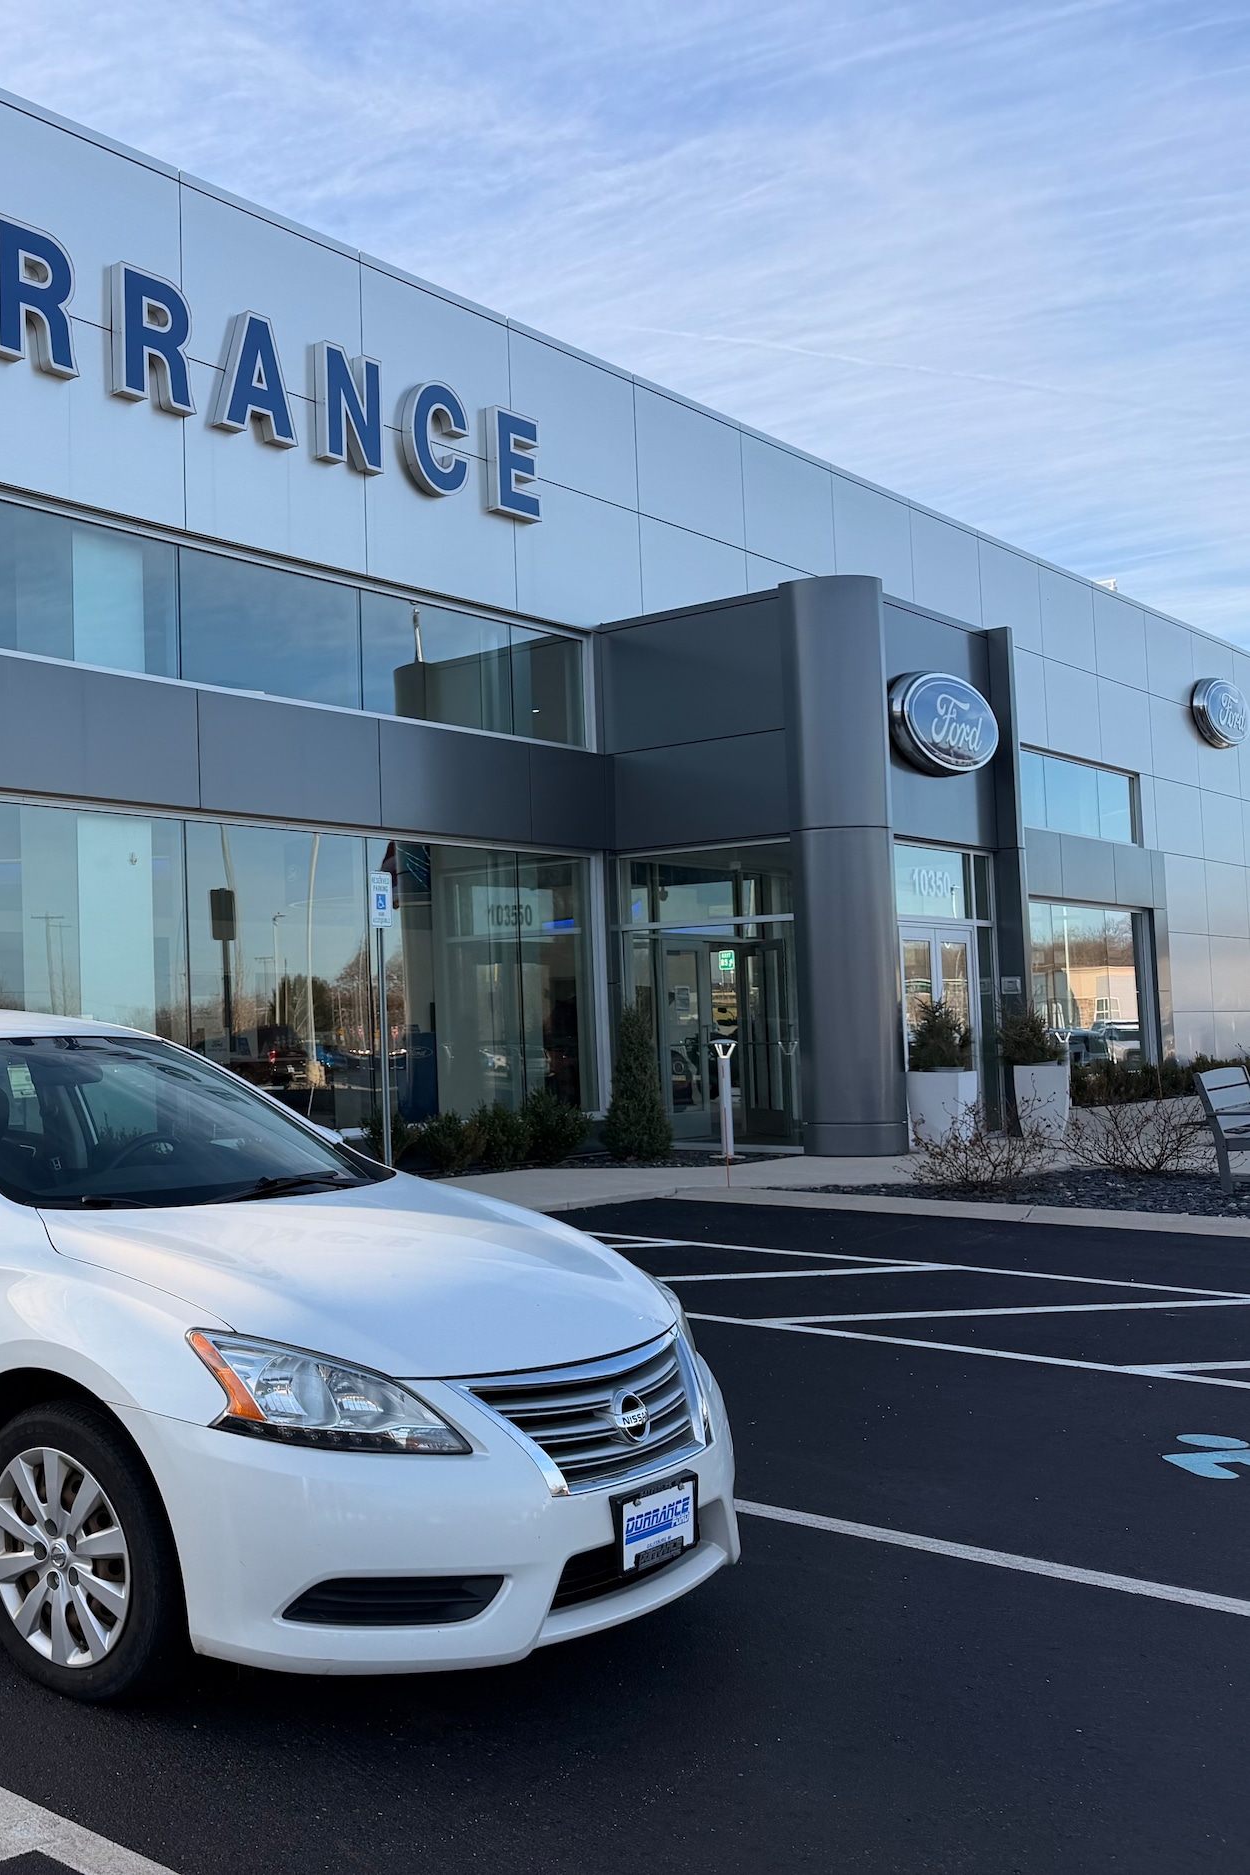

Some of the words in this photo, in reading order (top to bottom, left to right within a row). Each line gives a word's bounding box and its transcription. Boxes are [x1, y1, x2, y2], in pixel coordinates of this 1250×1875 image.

[931, 693, 983, 752] Ford
[1219, 692, 1246, 732] Ford
[371, 876, 390, 885] RESERVED
[372, 885, 389, 893] PARKING
[912, 868, 951, 898] 10350
[625, 1496, 690, 1535] DORRANCE
